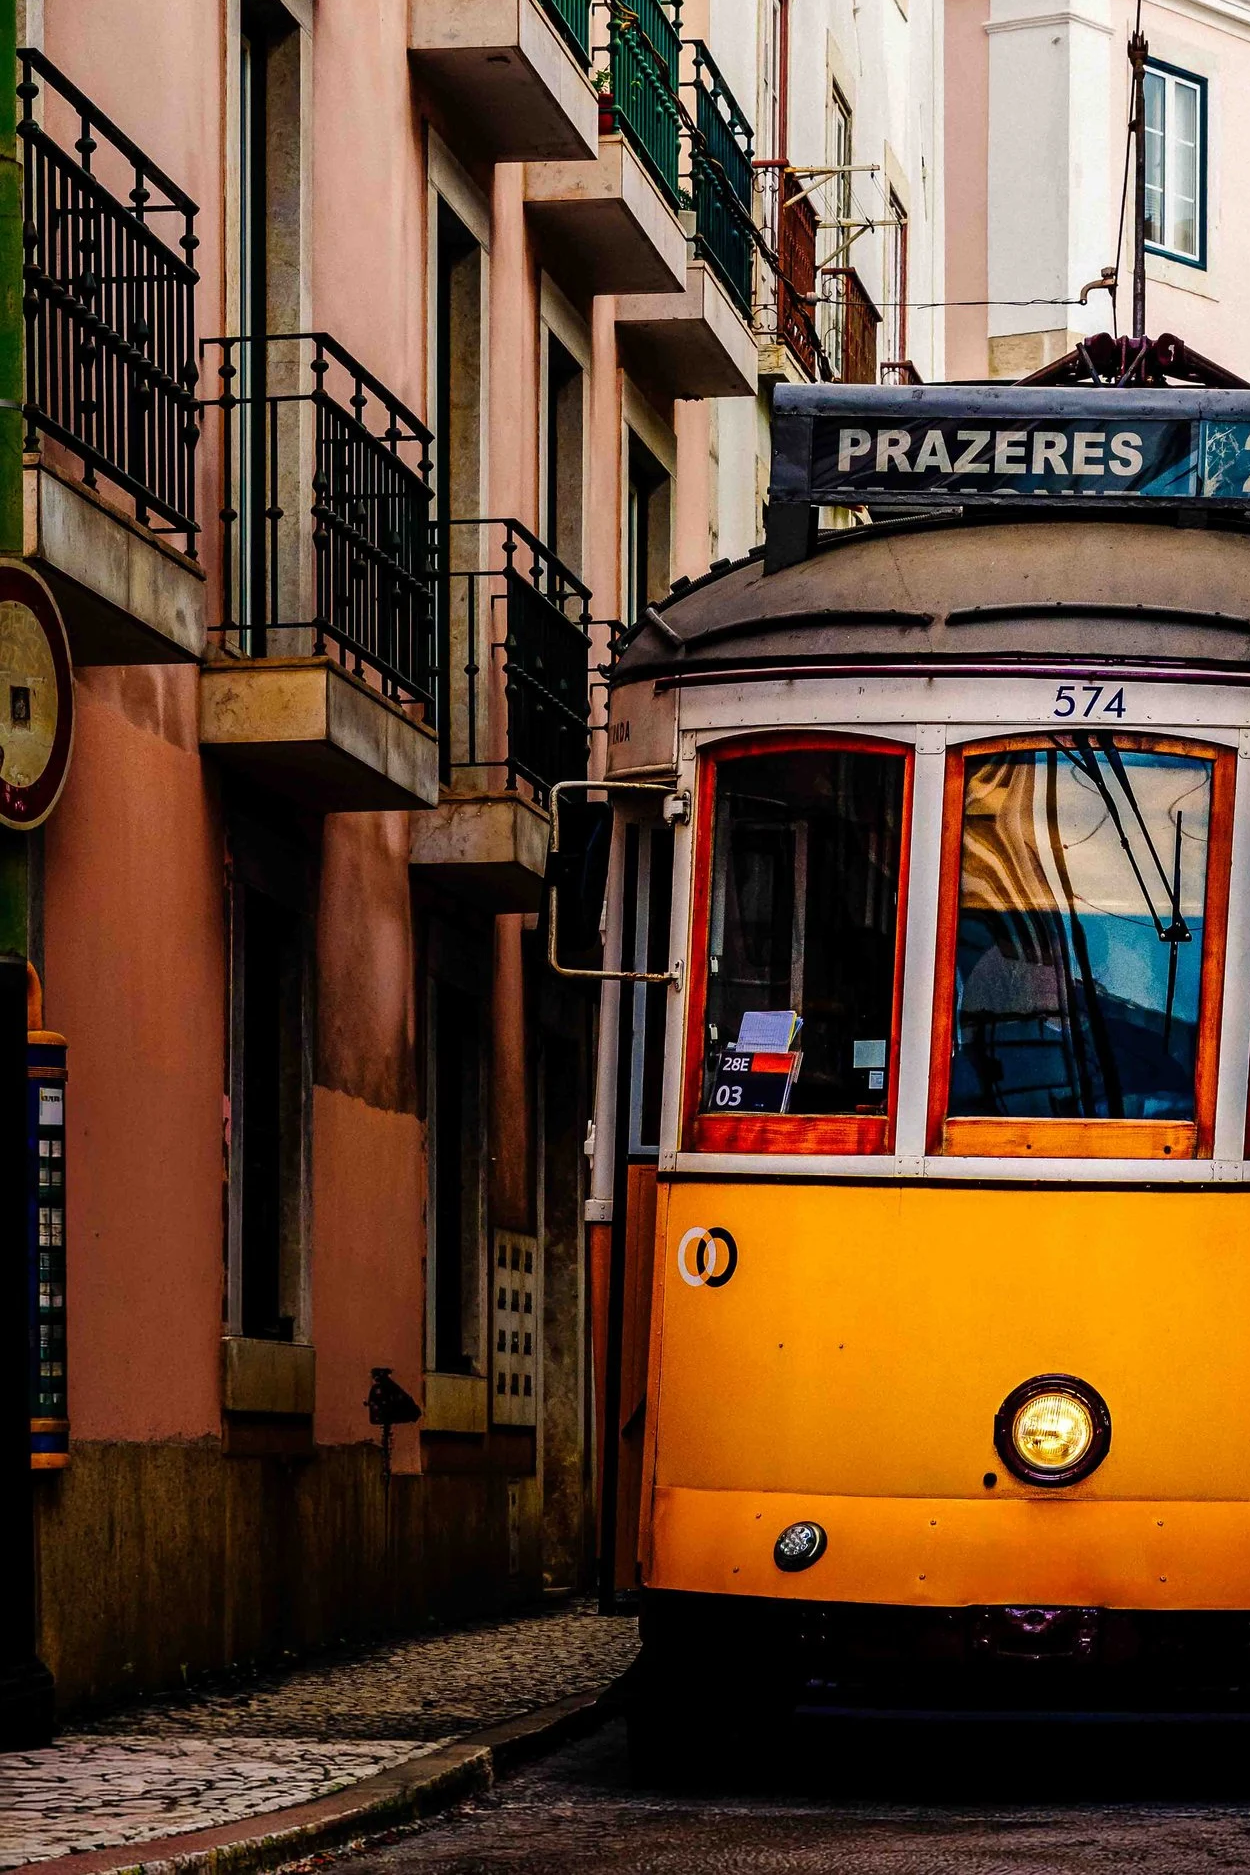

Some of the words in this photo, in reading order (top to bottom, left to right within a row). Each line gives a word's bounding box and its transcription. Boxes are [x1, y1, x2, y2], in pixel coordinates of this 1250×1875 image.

[837, 428, 1143, 476] PRAZERES
[1053, 685, 1127, 719] 574
[722, 1057, 750, 1072] 28E
[715, 1085, 743, 1107] 03
